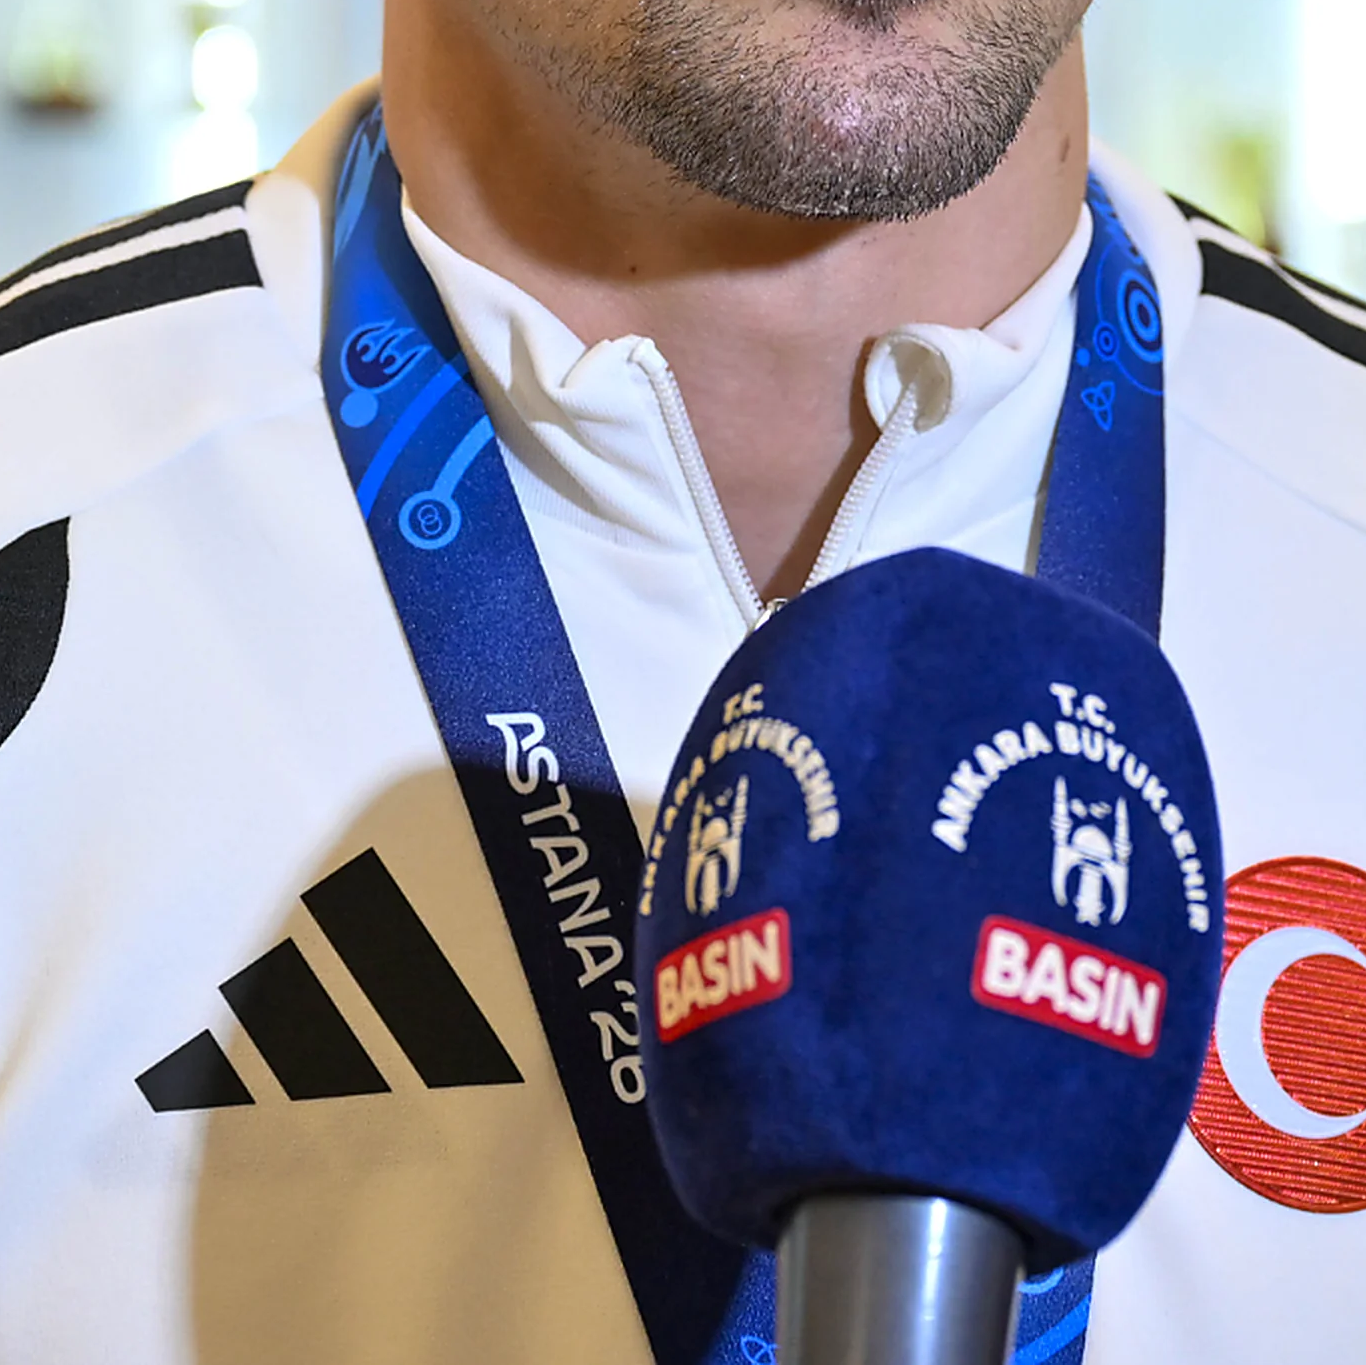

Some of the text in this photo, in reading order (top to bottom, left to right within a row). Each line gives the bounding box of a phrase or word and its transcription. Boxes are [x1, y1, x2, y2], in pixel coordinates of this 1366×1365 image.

[1049, 681, 1117, 735] T.C.
[931, 720, 1054, 853] ANKARA
[657, 920, 782, 1031] BASIN
[981, 926, 1160, 1047] BASIN
